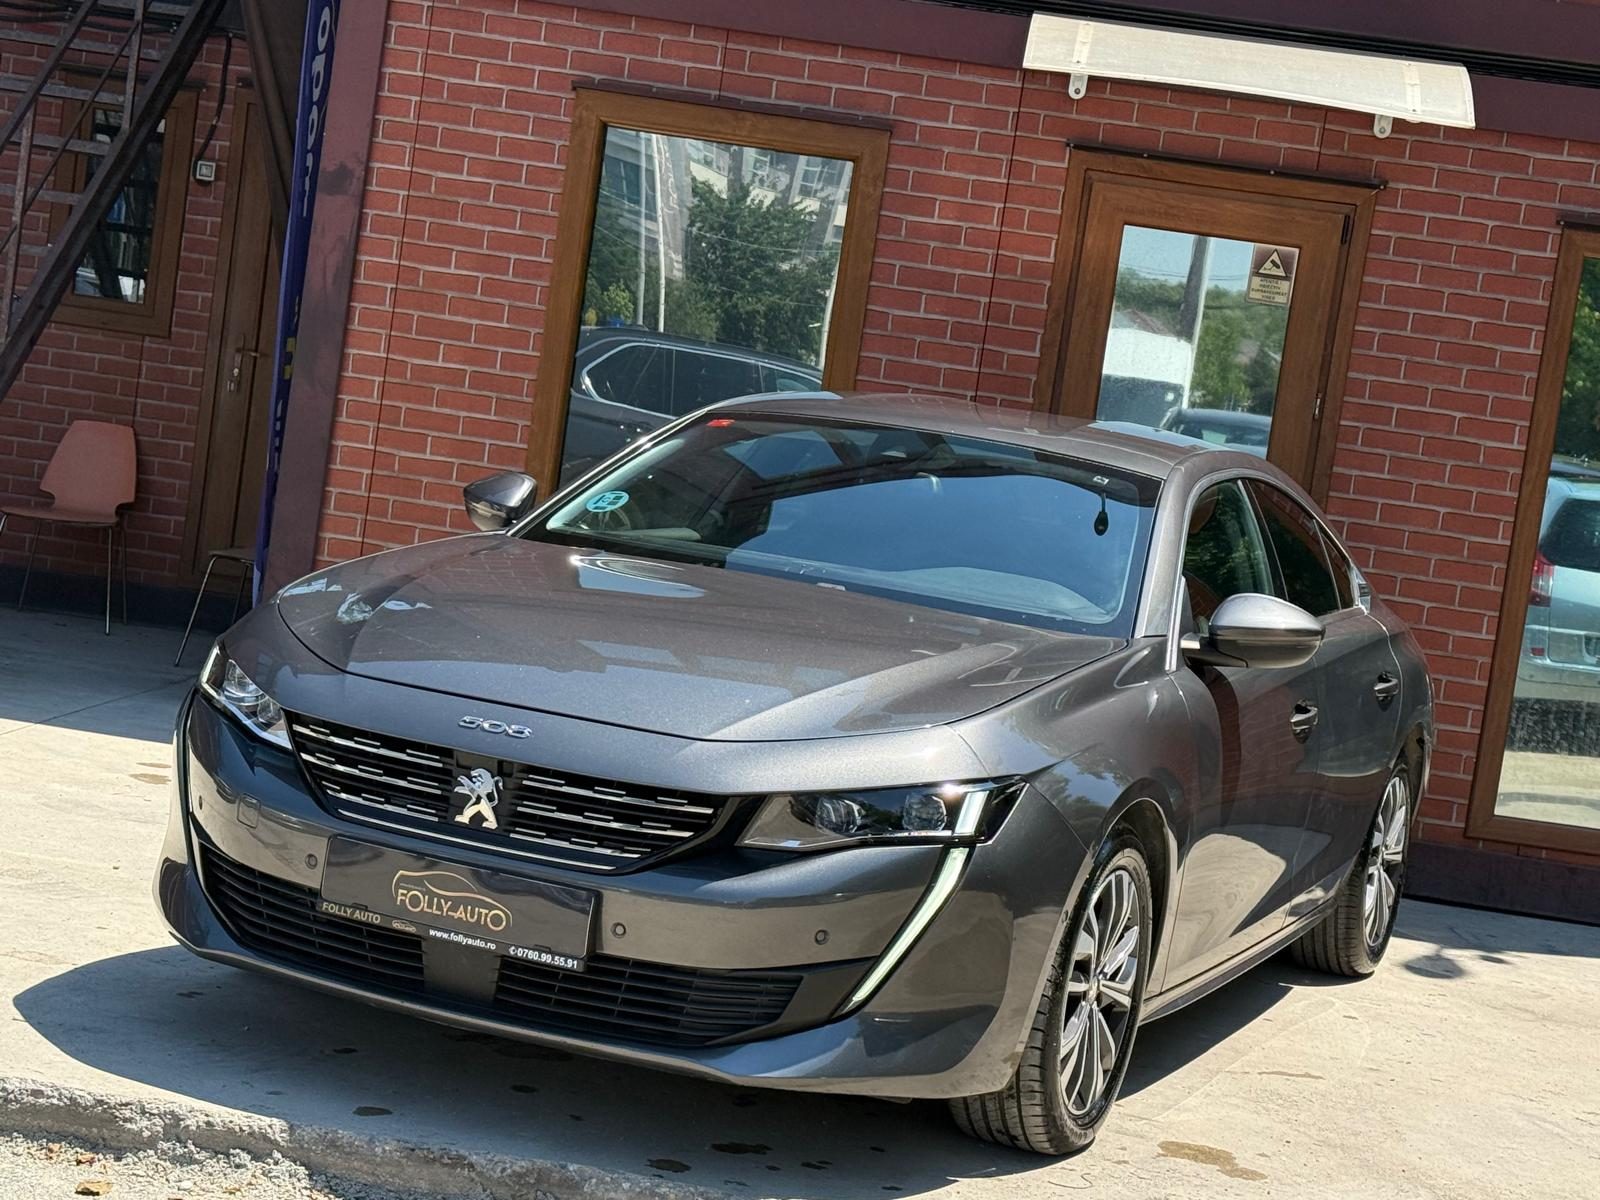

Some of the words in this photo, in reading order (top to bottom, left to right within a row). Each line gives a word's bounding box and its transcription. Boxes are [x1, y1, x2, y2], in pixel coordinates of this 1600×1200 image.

[457, 715, 532, 738] 508
[322, 902, 353, 917] FOLLY
[353, 909, 381, 924] AUTO
[429, 928, 496, 950] www.follyauto.ro
[517, 949, 577, 969] 0760.99.55.91
